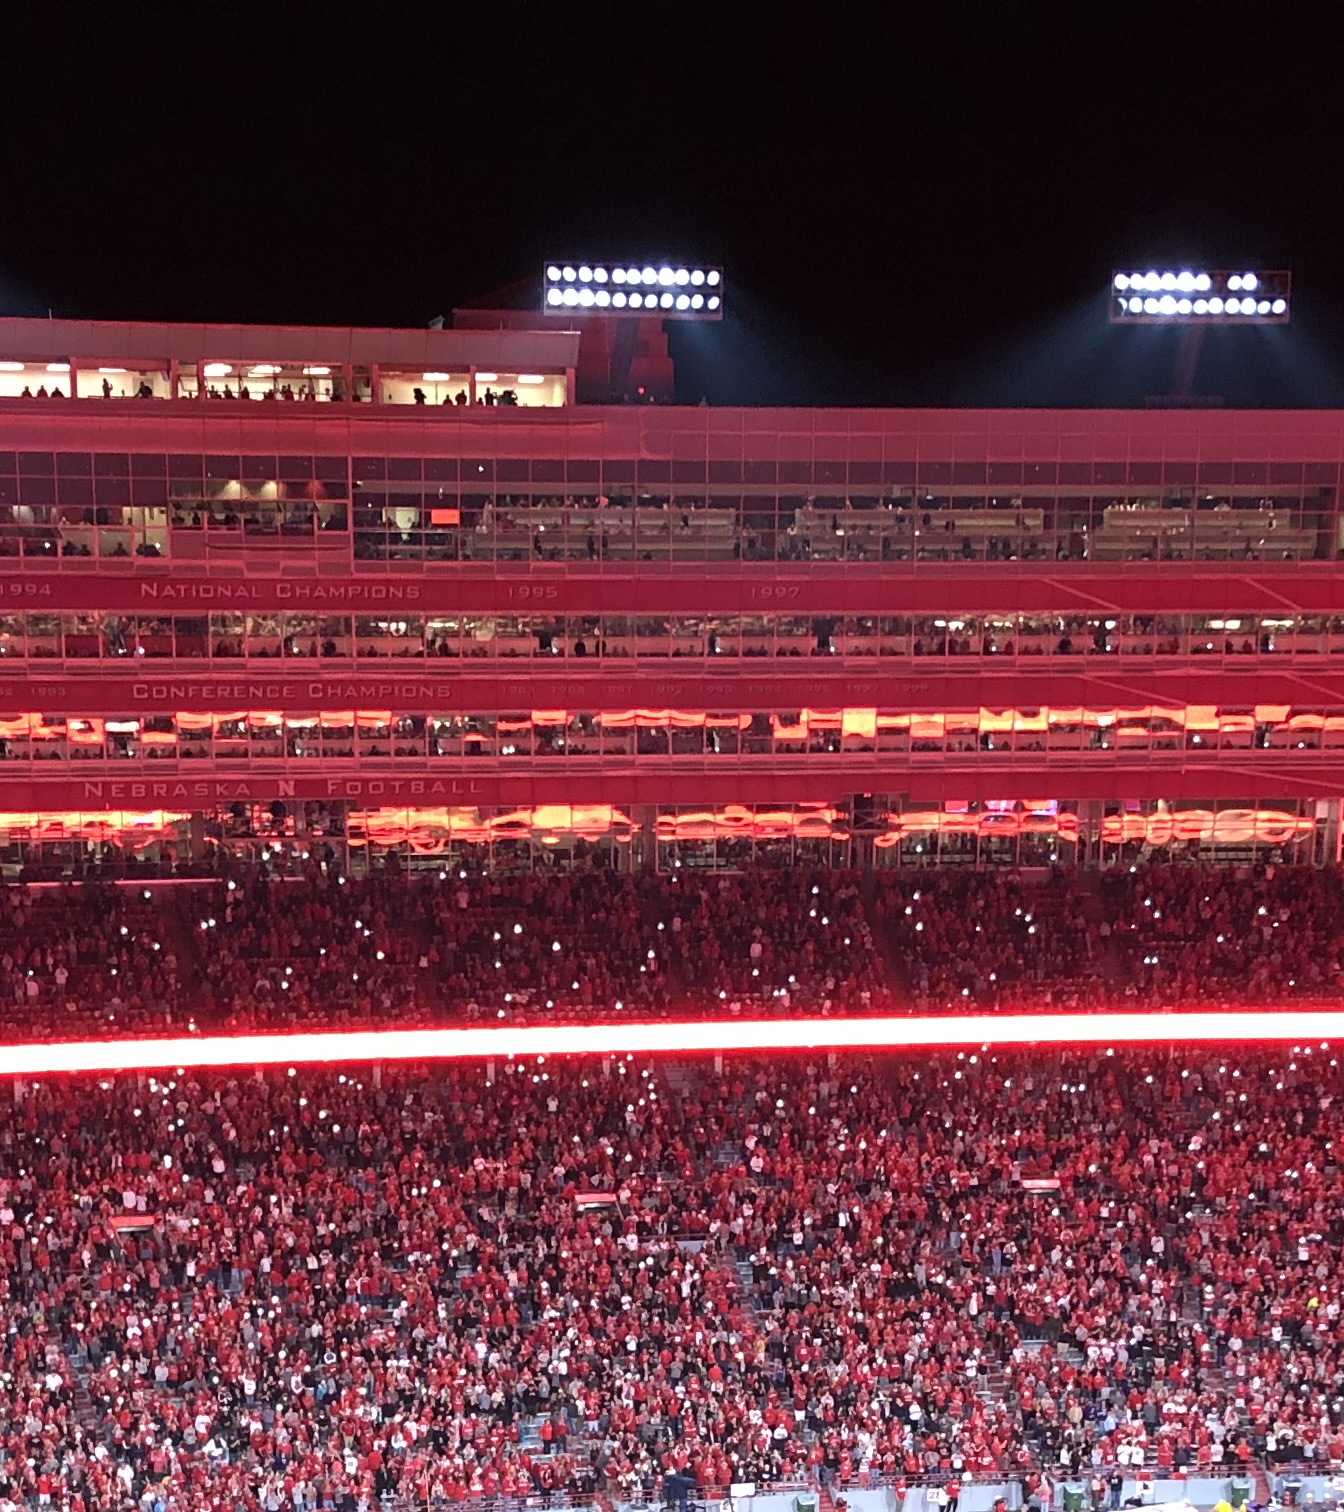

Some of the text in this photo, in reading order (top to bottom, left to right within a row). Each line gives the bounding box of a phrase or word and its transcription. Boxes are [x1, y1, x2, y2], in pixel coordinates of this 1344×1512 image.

[140, 582, 263, 599] NATIONAL
[275, 582, 421, 599] CHAMPIONS
[507, 585, 559, 599] 1995
[751, 586, 801, 600] 1997
[131, 683, 296, 700] CONFERENCE
[308, 682, 451, 699] CHAMPIONS
[83, 778, 484, 798] NEBRASKA N FOOTBALL
